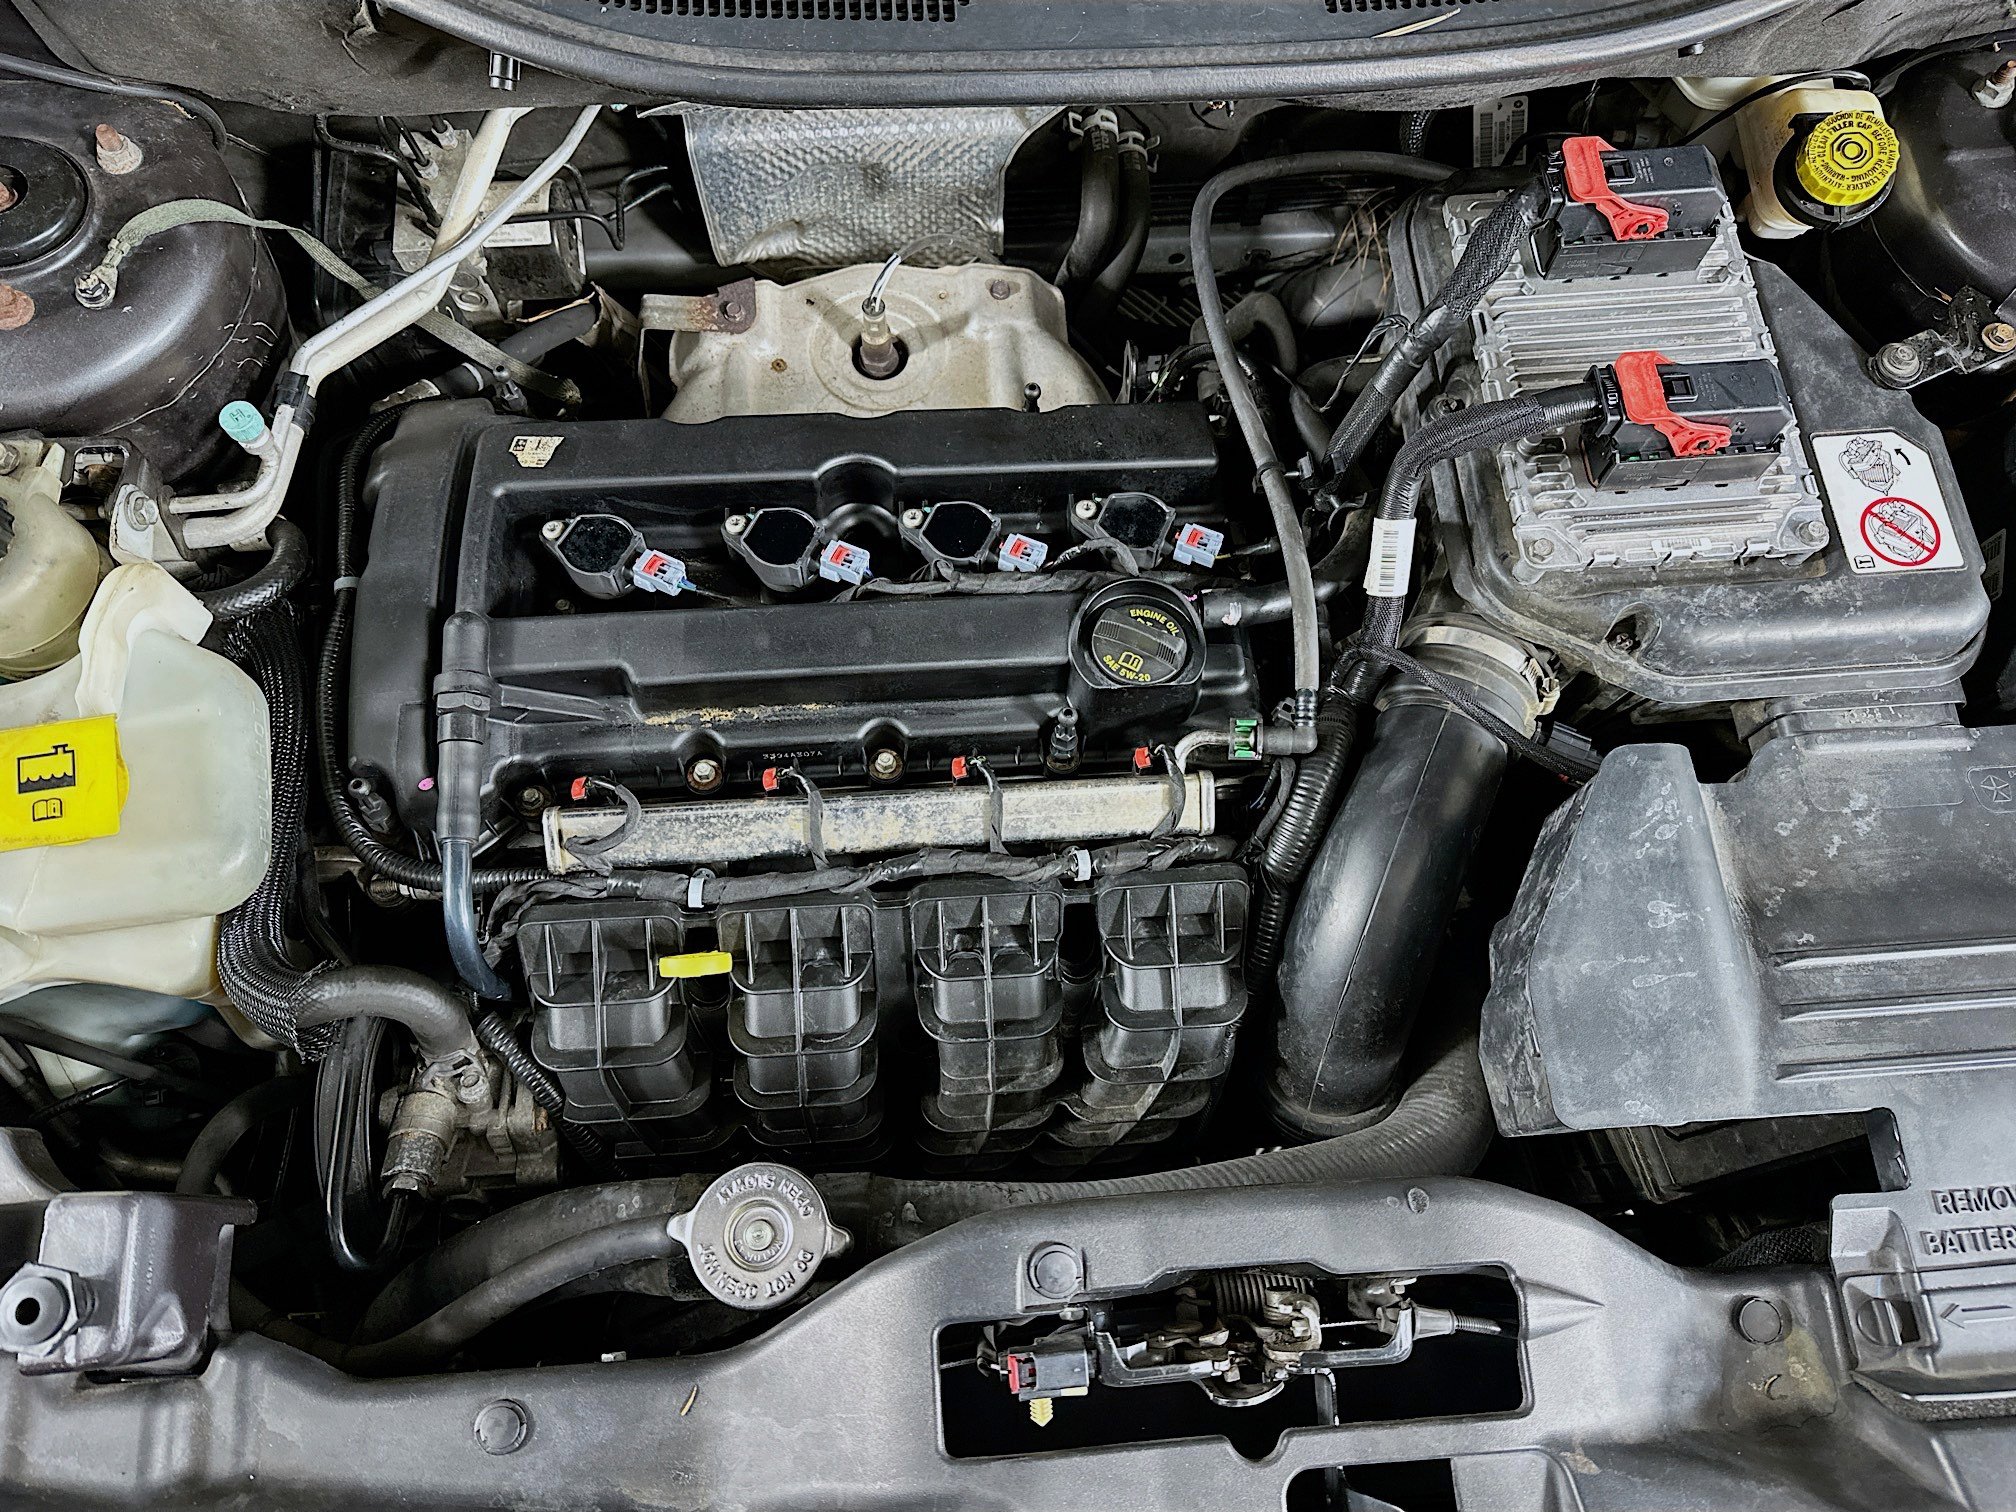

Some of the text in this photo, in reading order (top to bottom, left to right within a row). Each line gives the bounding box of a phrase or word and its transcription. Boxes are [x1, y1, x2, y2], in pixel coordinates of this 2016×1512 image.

[1826, 112, 1853, 126] BOUCHON
[1828, 121, 1854, 135] FILLER
[1857, 121, 1873, 130] CAP
[1866, 114, 1896, 147] REMPLISSAGE
[1817, 135, 1829, 157] CLEAN
[1872, 130, 1887, 155] BEFORE
[1851, 158, 1885, 182] REMOVING
[1888, 149, 1896, 168] AVANT
[1880, 169, 1889, 178] DE
[1129, 609, 1167, 624] ENGINE
[1165, 620, 1180, 636] OIL
[1103, 654, 1151, 681] SAE 5W-20
[258, 768, 270, 846] FULL
[716, 1173, 814, 1217] OPEN SLOWLY
[1920, 1225, 2016, 1255] BATTER
[697, 1243, 814, 1299] DO NOT OPEN HOT
